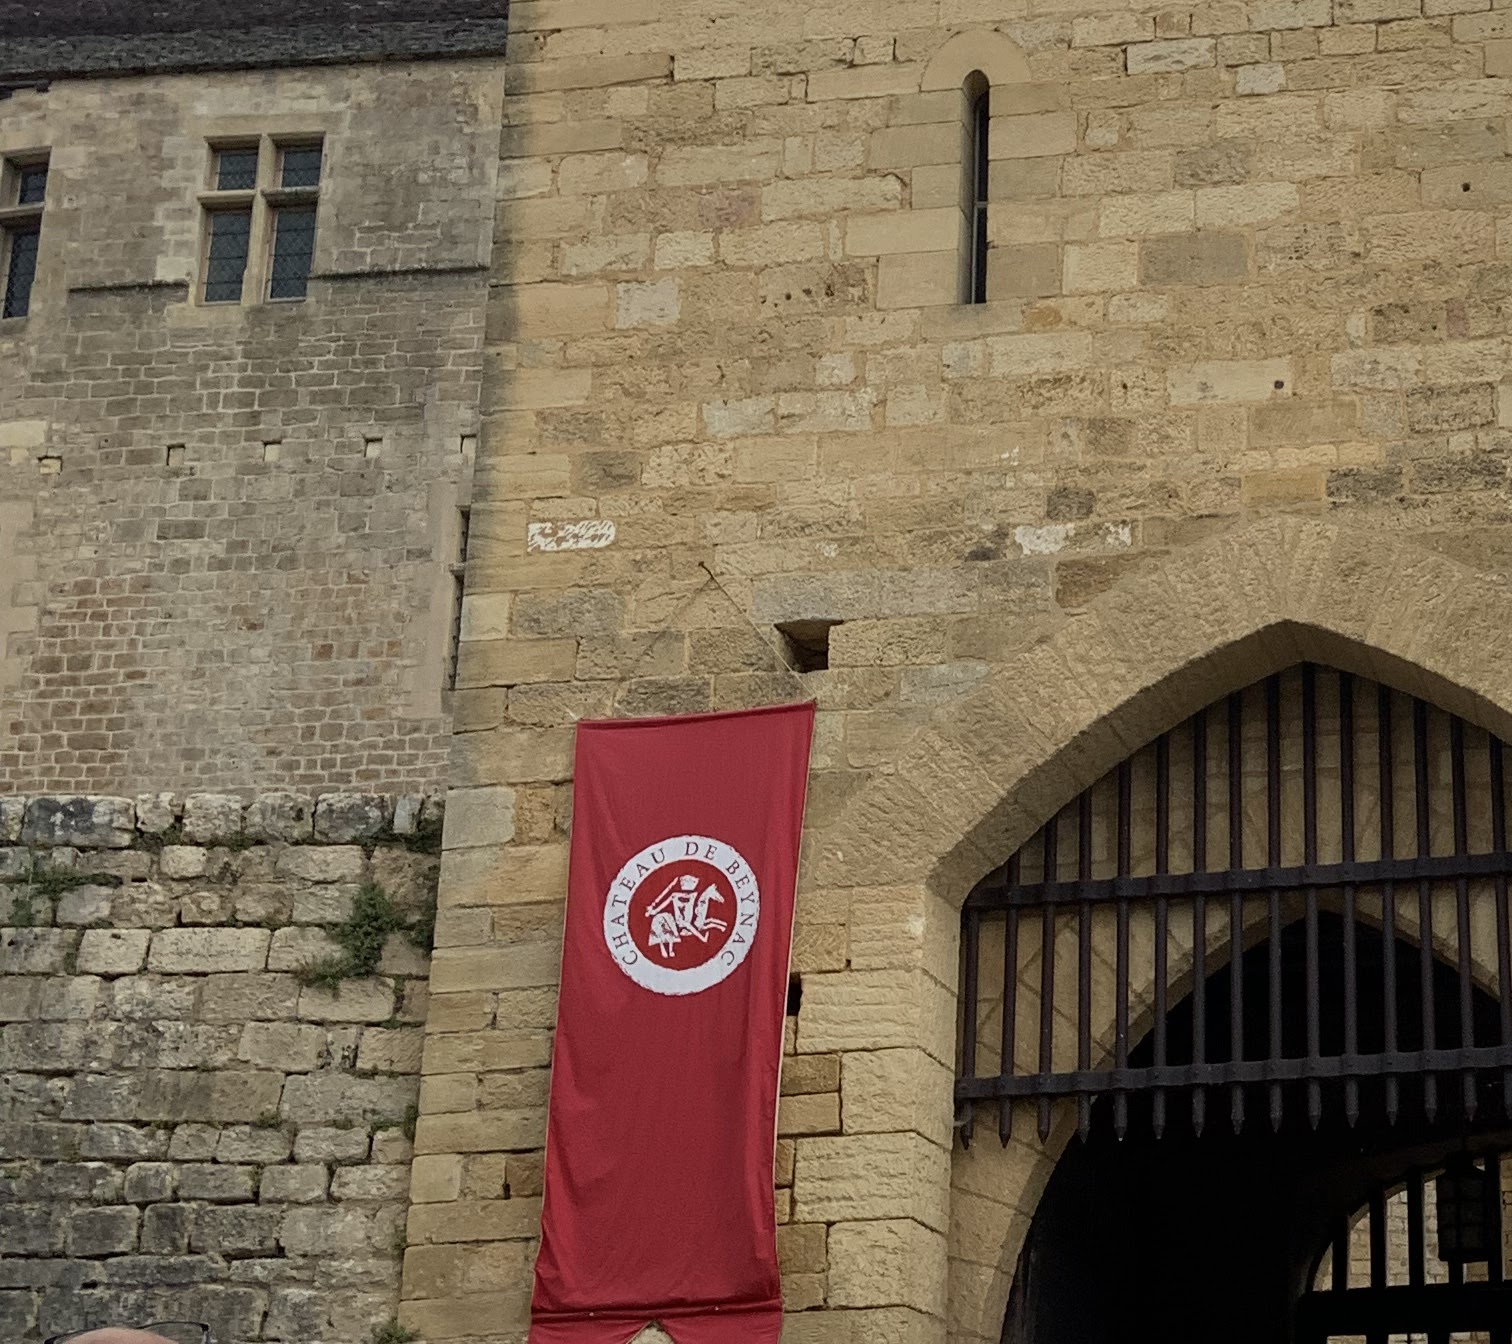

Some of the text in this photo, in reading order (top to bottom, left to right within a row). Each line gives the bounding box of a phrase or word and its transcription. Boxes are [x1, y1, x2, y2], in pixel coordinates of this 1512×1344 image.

[610, 841, 755, 967] CHATEAU DE BEYNAC
